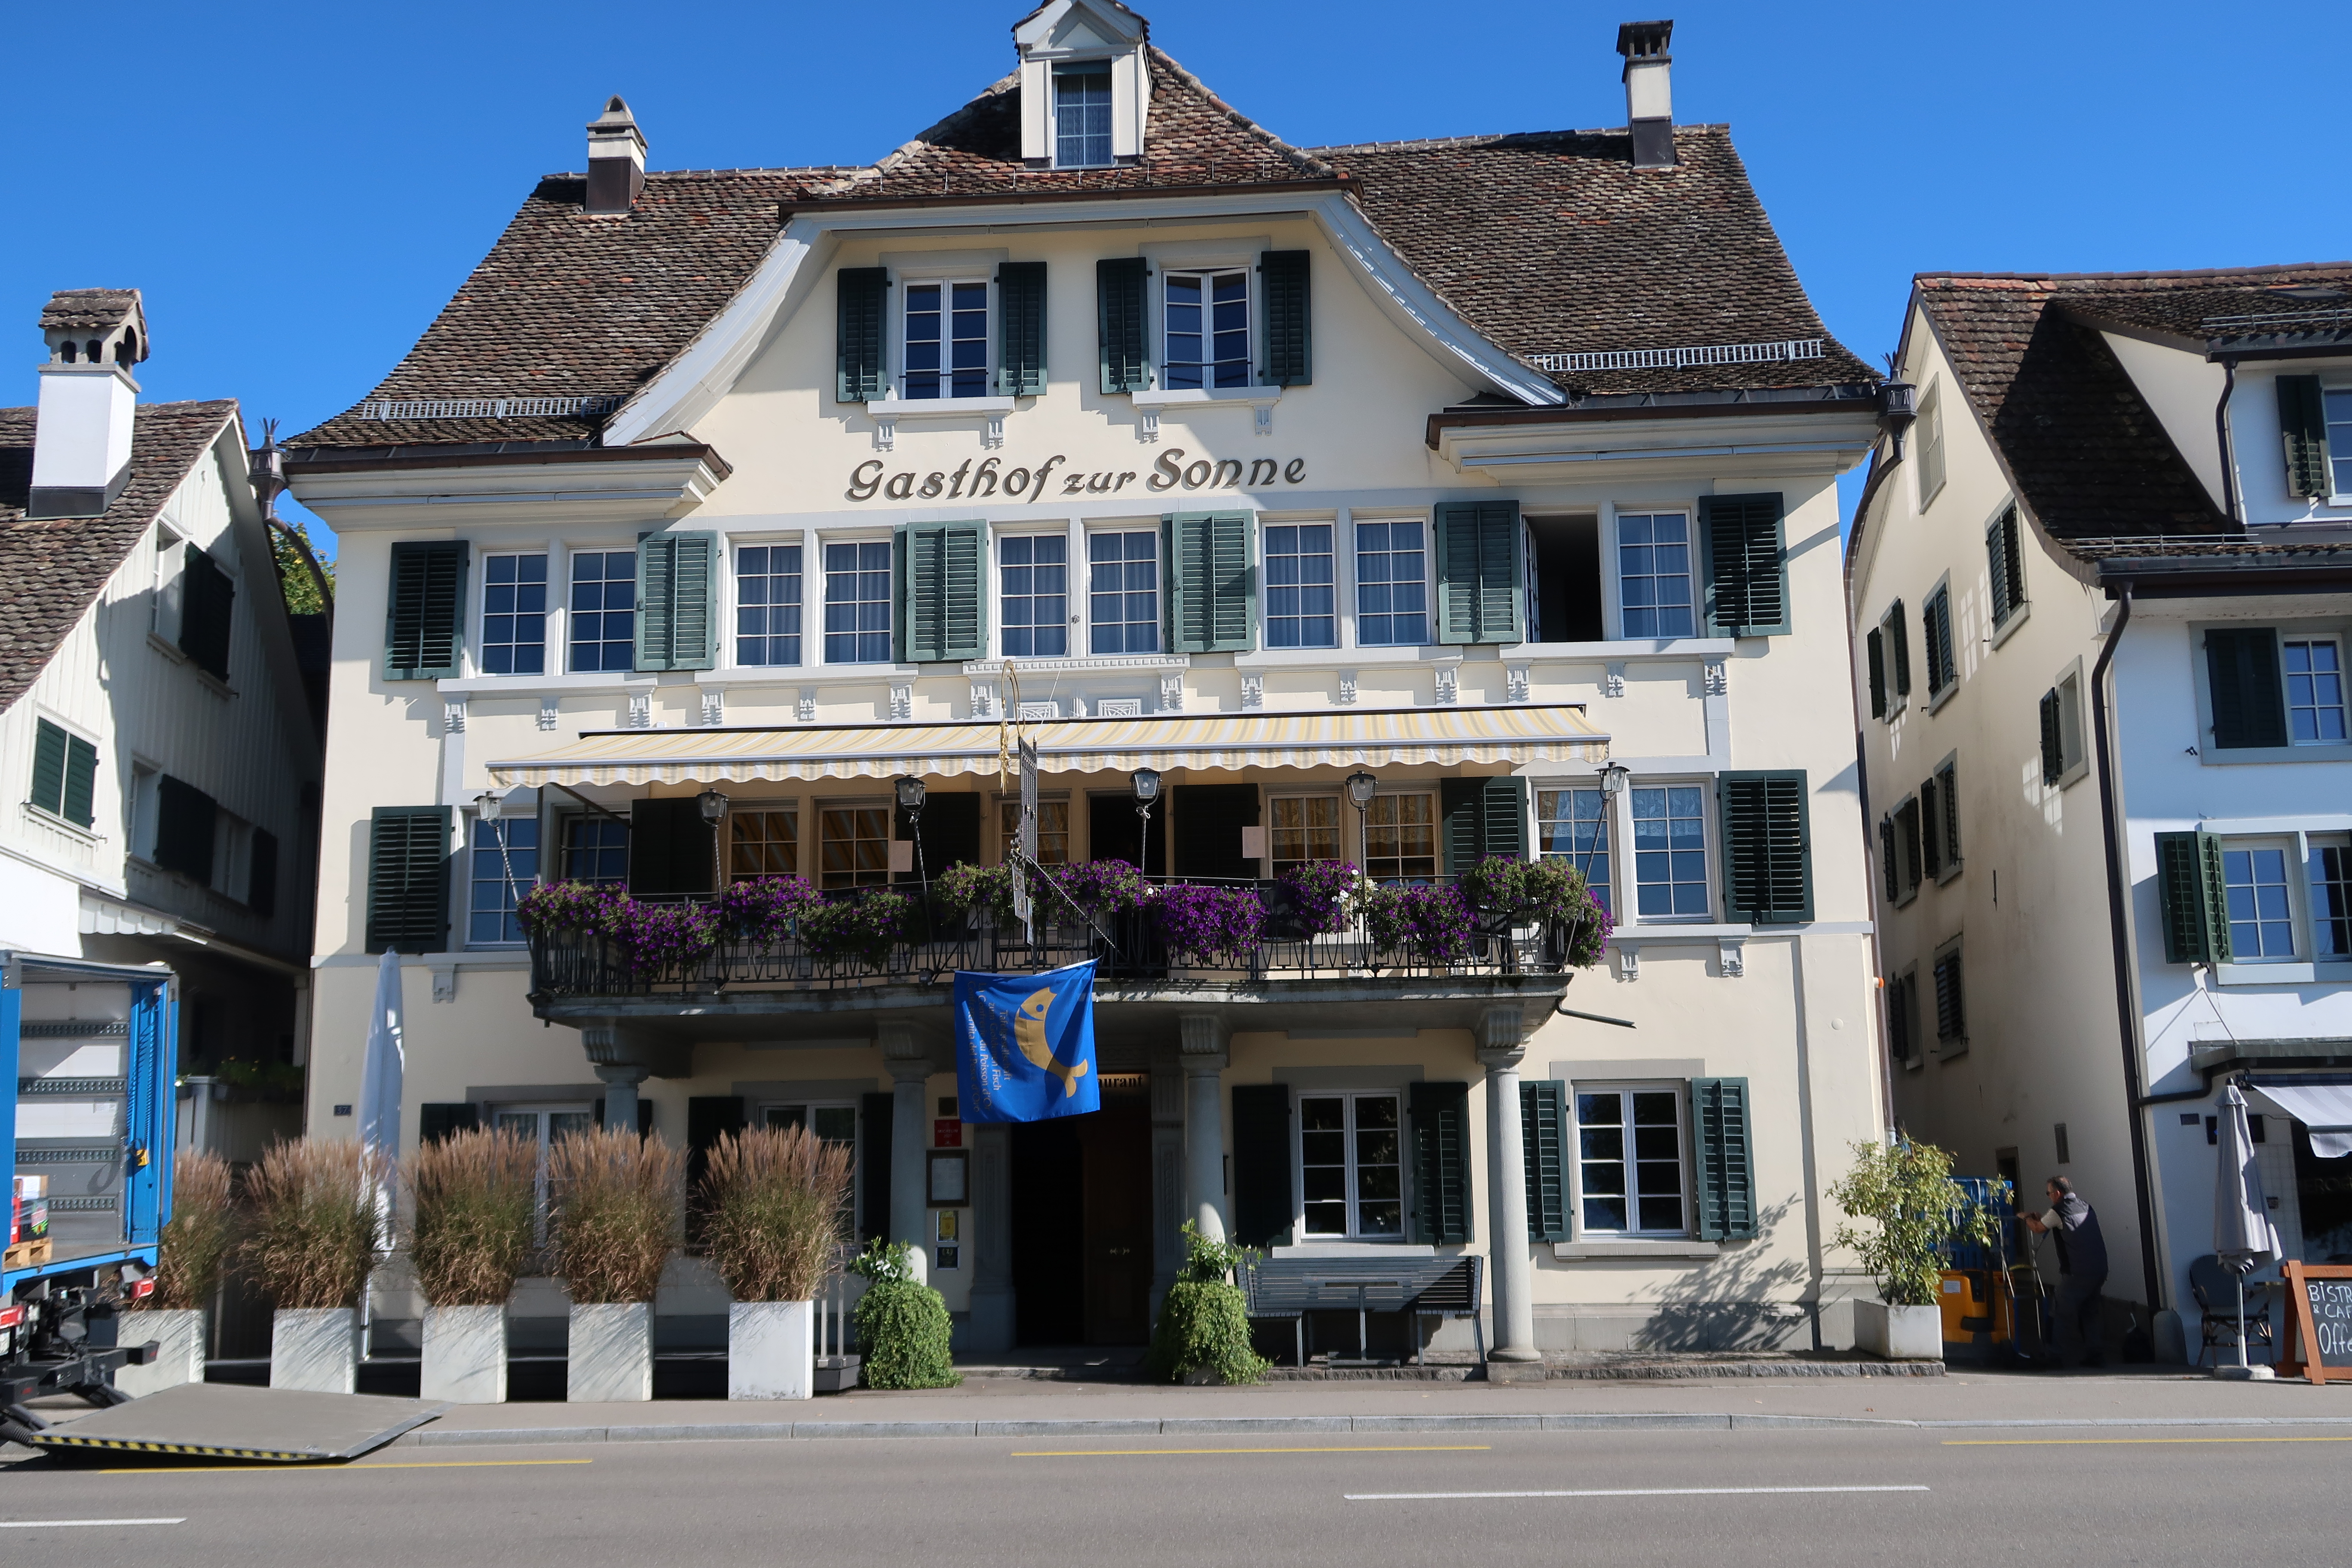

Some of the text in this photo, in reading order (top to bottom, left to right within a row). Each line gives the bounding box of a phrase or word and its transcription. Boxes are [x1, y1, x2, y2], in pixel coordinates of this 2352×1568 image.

[845, 448, 1306, 503] Gasthof zur Sonne
[968, 1042, 977, 1055] del
[980, 1039, 986, 1051] du
[990, 1023, 998, 1066] Goldenen
[999, 1010, 1012, 1081] Tafelgesellschaft
[980, 1054, 989, 1086] Poisson
[992, 1069, 1001, 1090] Fisch
[337, 1106, 348, 1115] 37
[2312, 1304, 2320, 1314] &
